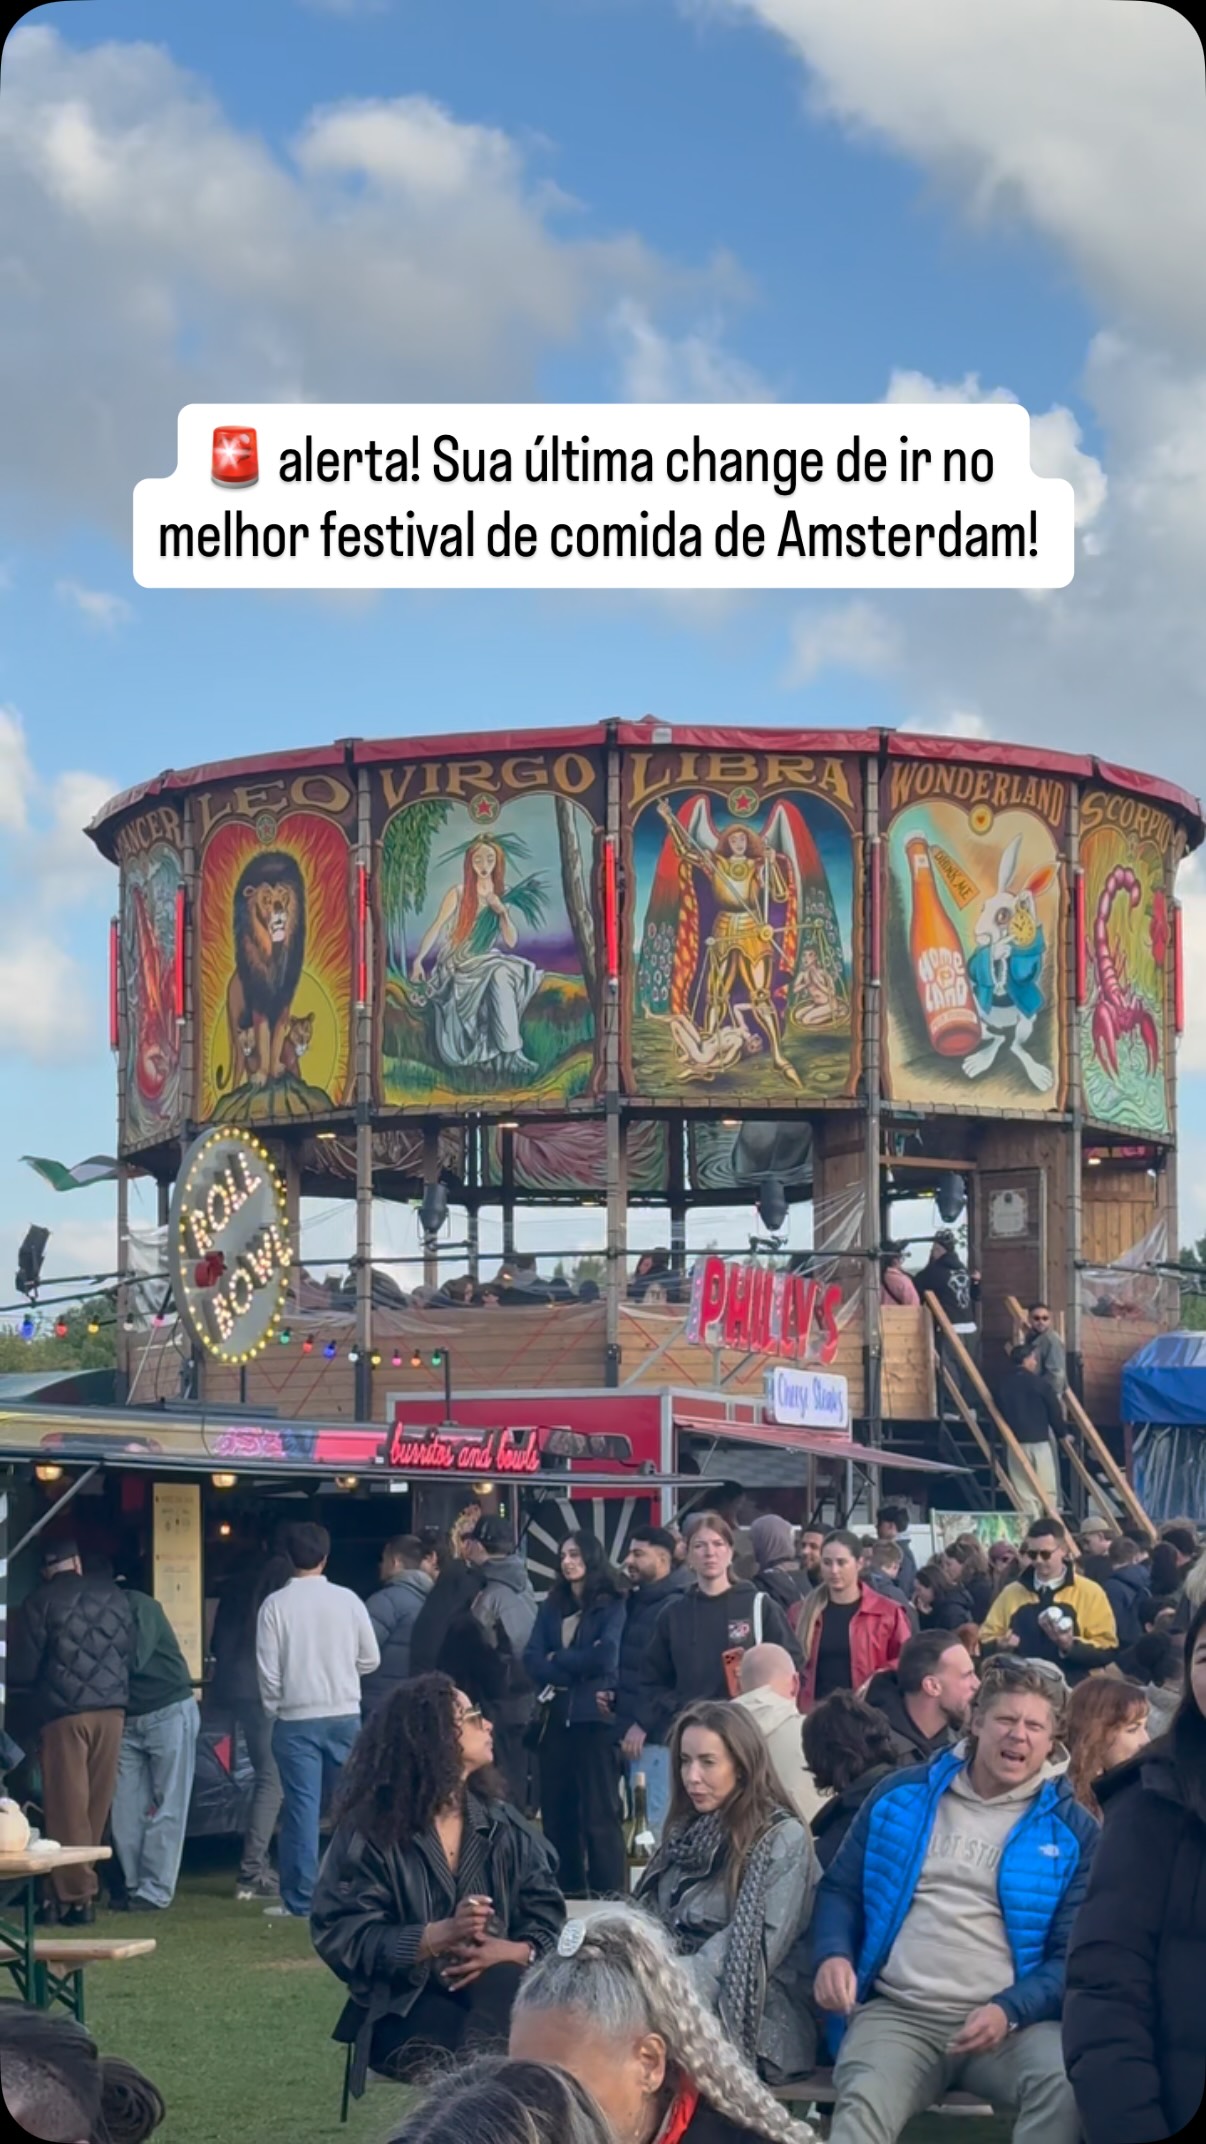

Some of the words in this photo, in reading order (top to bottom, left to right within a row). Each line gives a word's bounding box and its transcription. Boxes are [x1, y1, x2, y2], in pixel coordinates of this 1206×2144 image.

[199, 773, 352, 837] LEO
[379, 751, 598, 811] VIRGO
[626, 752, 856, 810] LIBRA
[888, 760, 1066, 829] WONDERLAND
[189, 1150, 263, 1257] ROLL
[211, 1223, 294, 1341] BOWL
[390, 1421, 455, 1467] burritos
[458, 1432, 494, 1469] and
[497, 1428, 541, 1472] bowls
